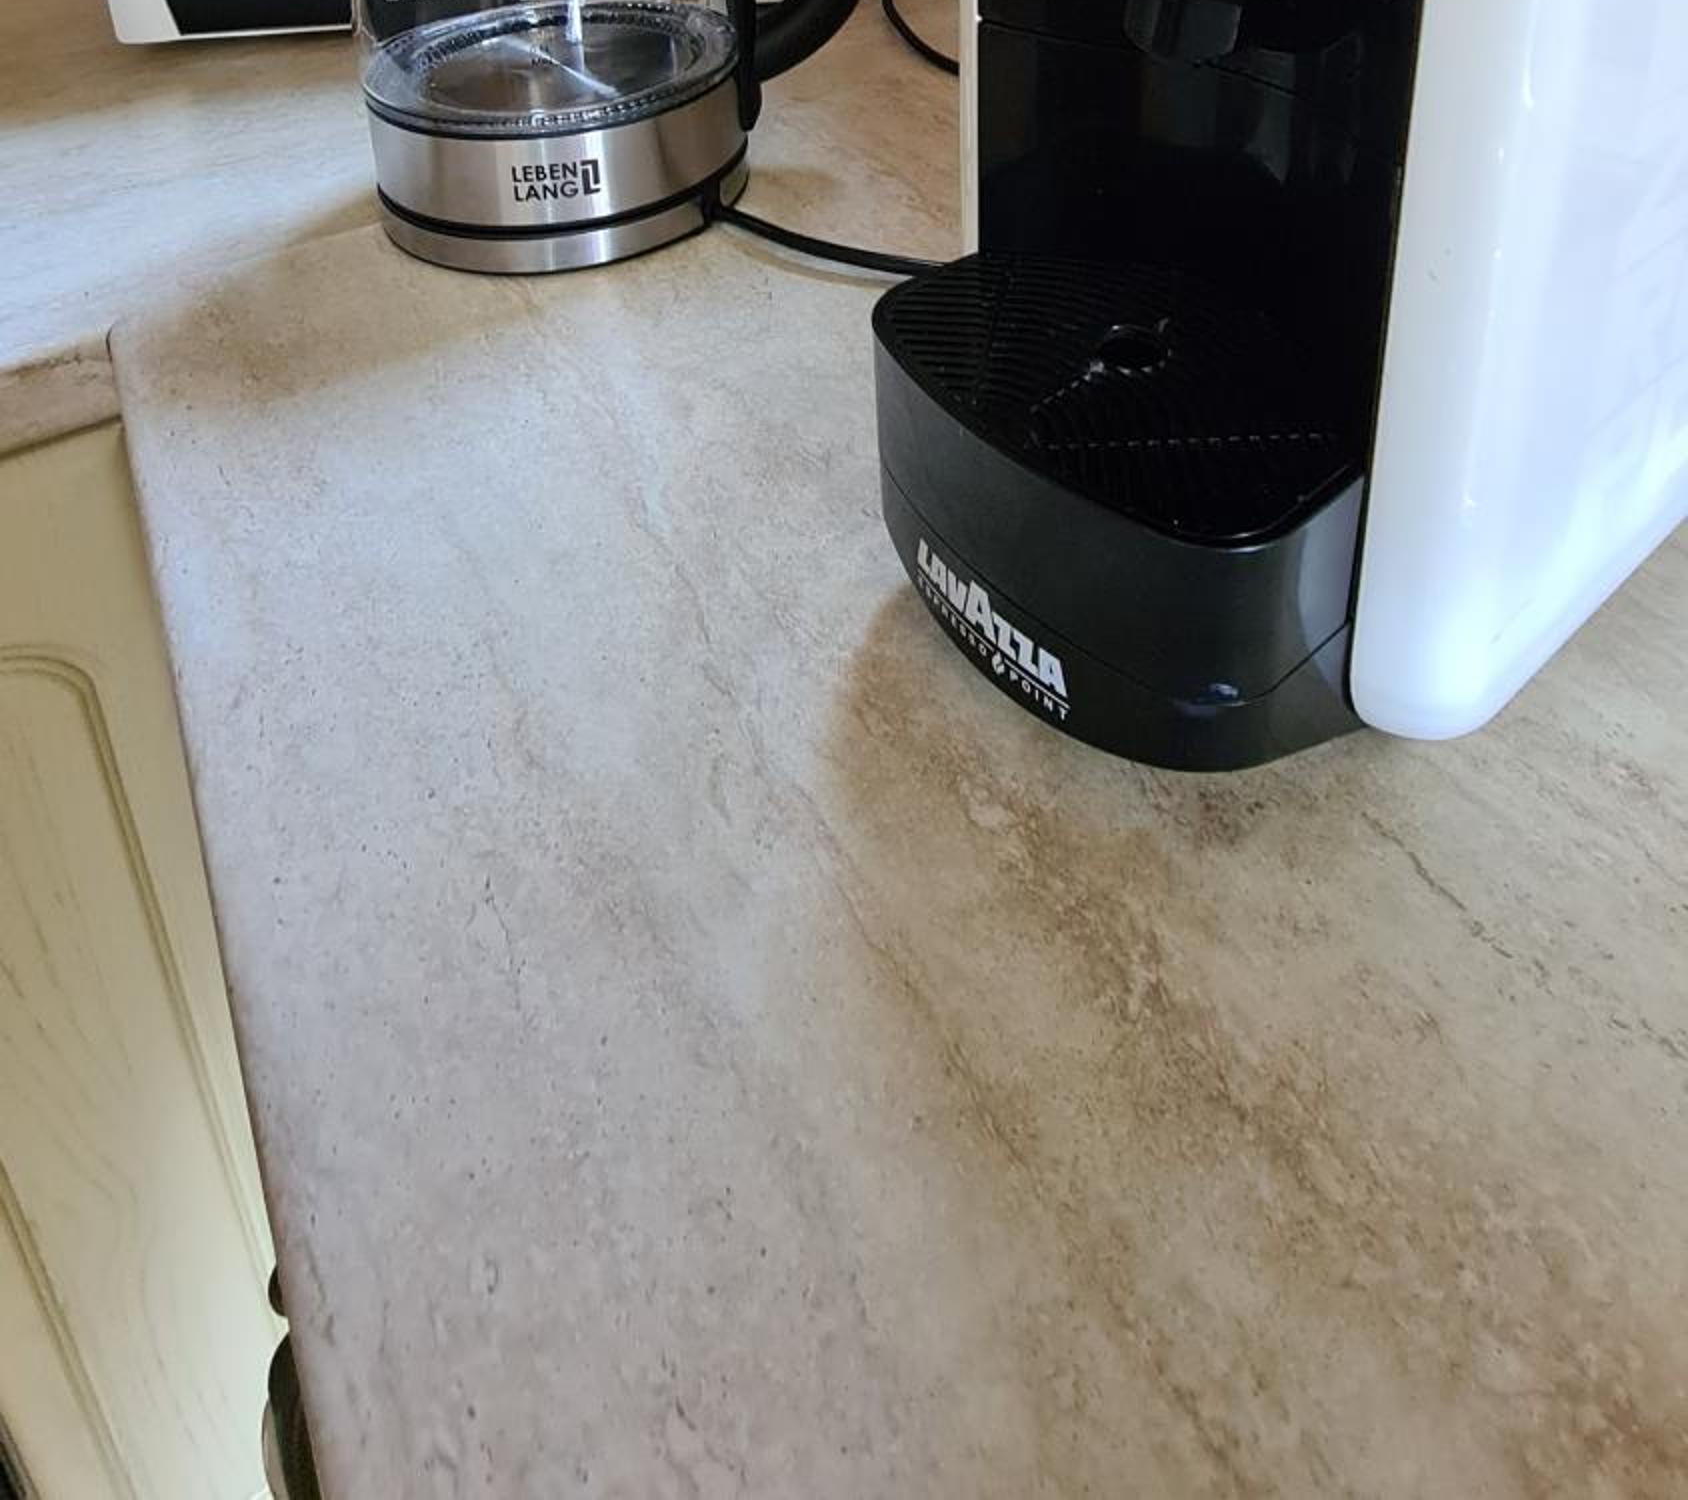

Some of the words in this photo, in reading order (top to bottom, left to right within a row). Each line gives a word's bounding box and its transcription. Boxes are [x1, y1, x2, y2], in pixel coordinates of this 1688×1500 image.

[511, 161, 578, 183] LEBEN
[514, 180, 579, 202] LANG
[917, 538, 1068, 698] LAVAZZA
[1009, 670, 1069, 720] POINT
